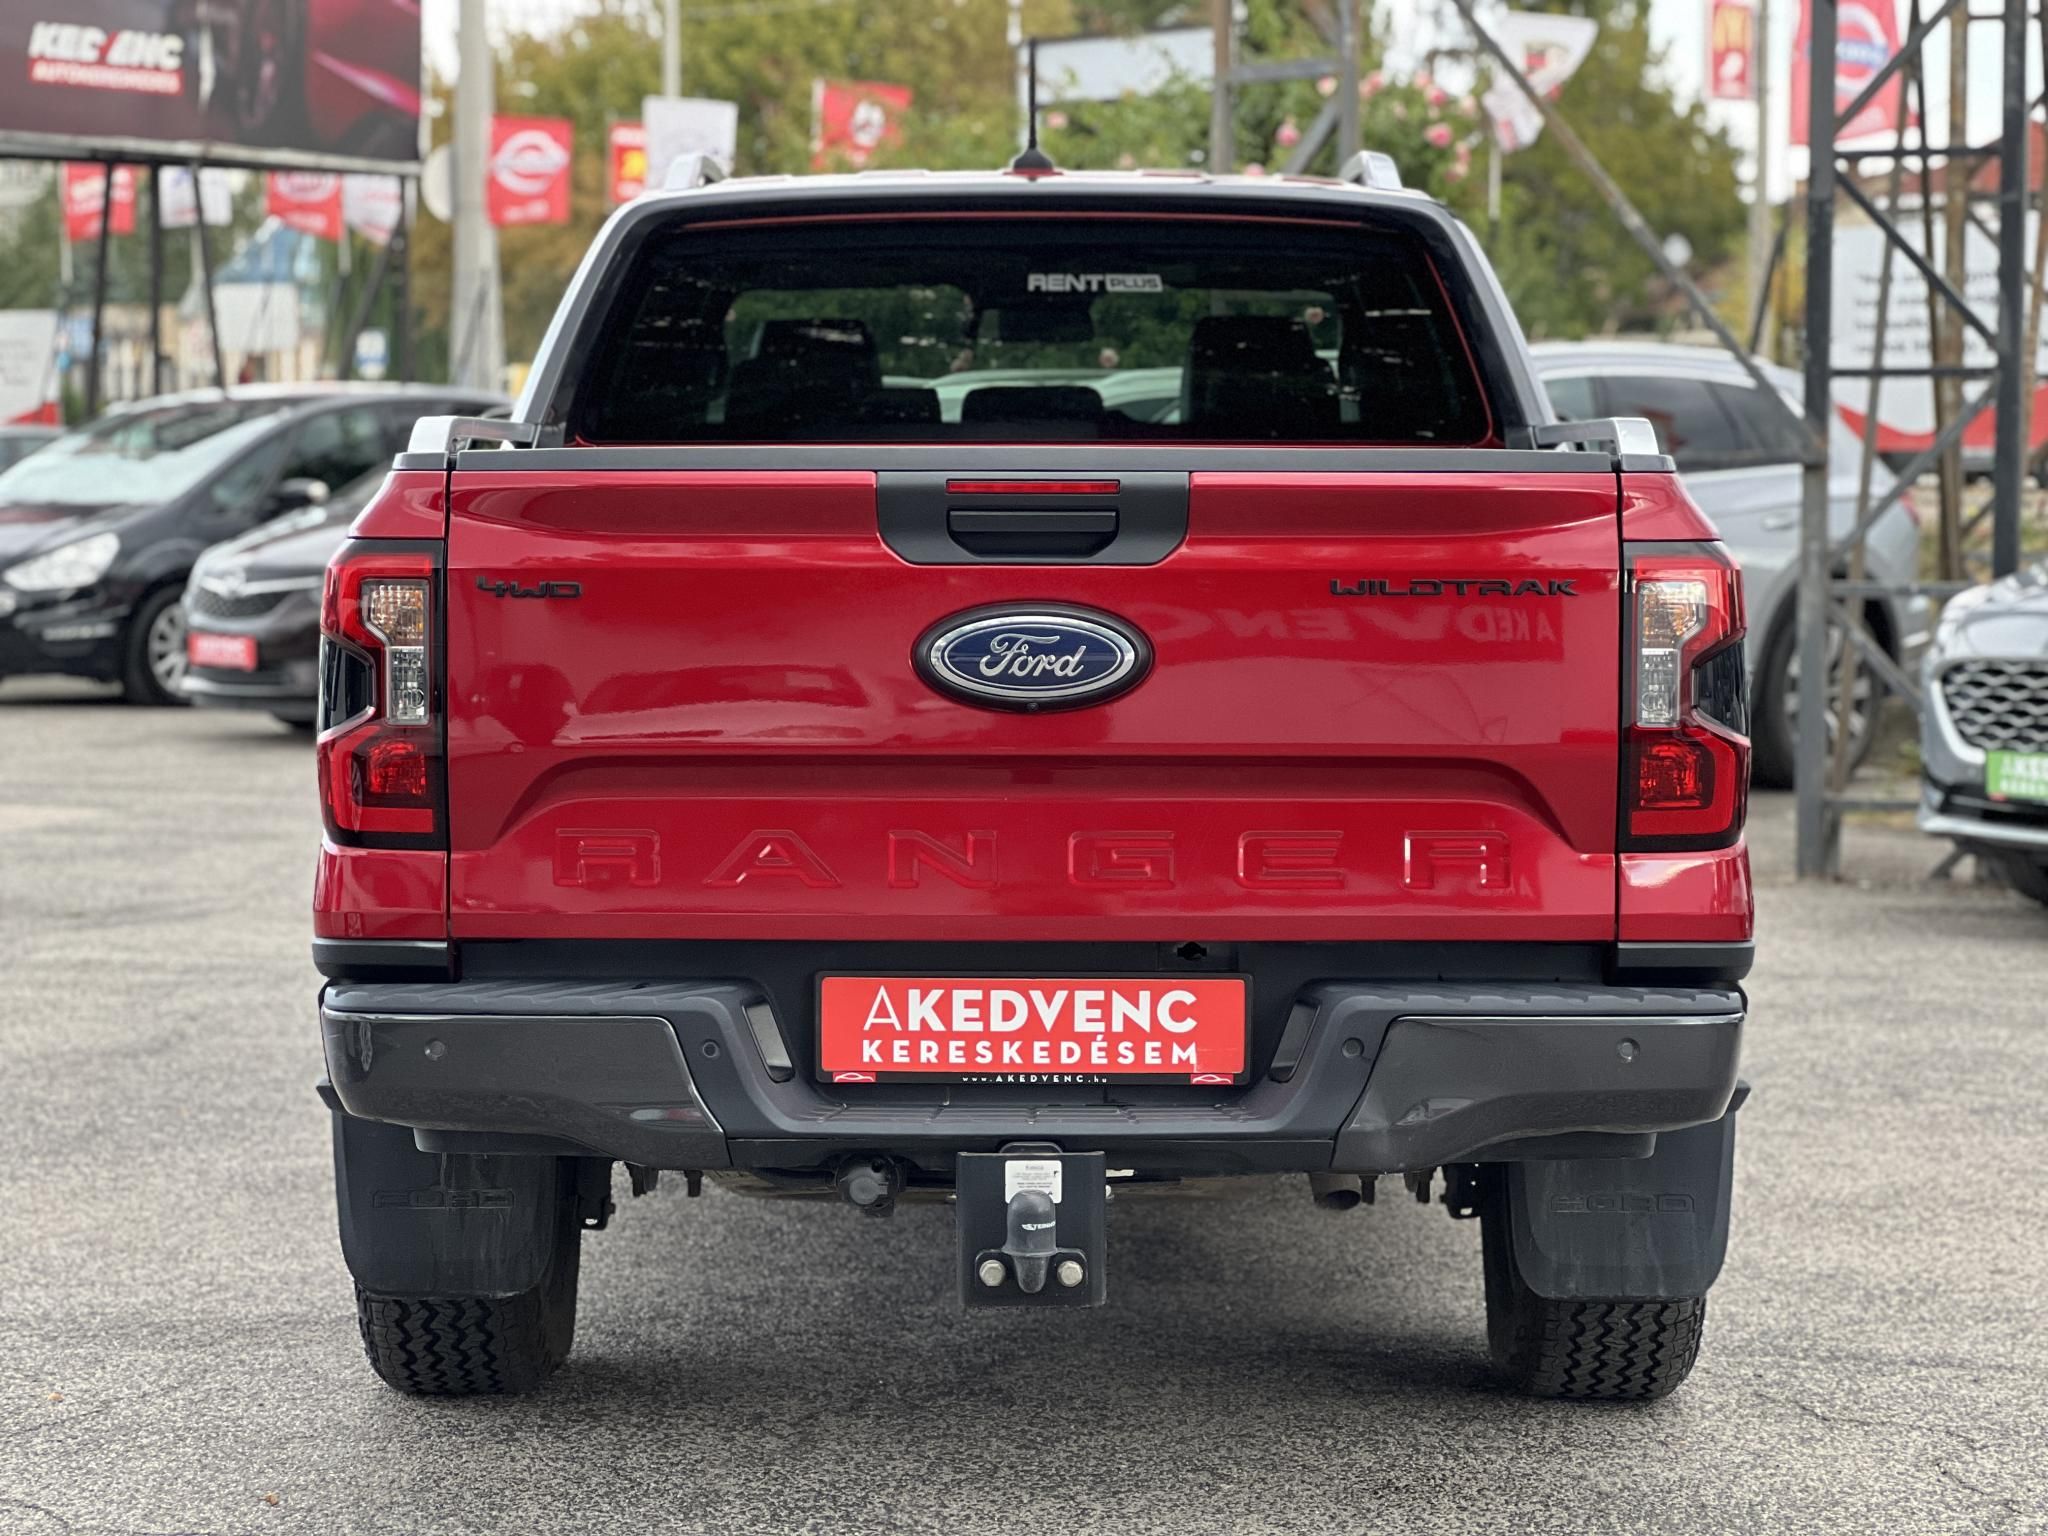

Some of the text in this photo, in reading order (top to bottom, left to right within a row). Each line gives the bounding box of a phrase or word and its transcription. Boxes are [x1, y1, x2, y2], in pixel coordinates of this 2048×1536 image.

[1027, 273, 1162, 292] RENT PLUS
[476, 576, 582, 598] 4WD
[1330, 579, 1578, 596] WILDTRAK
[980, 633, 1086, 677] Ford
[554, 828, 1511, 889] RANGER
[862, 1035, 1198, 1065] KERESKEDÉSEM
[962, 1074, 1108, 1084] www.AKEDVENC.hu
